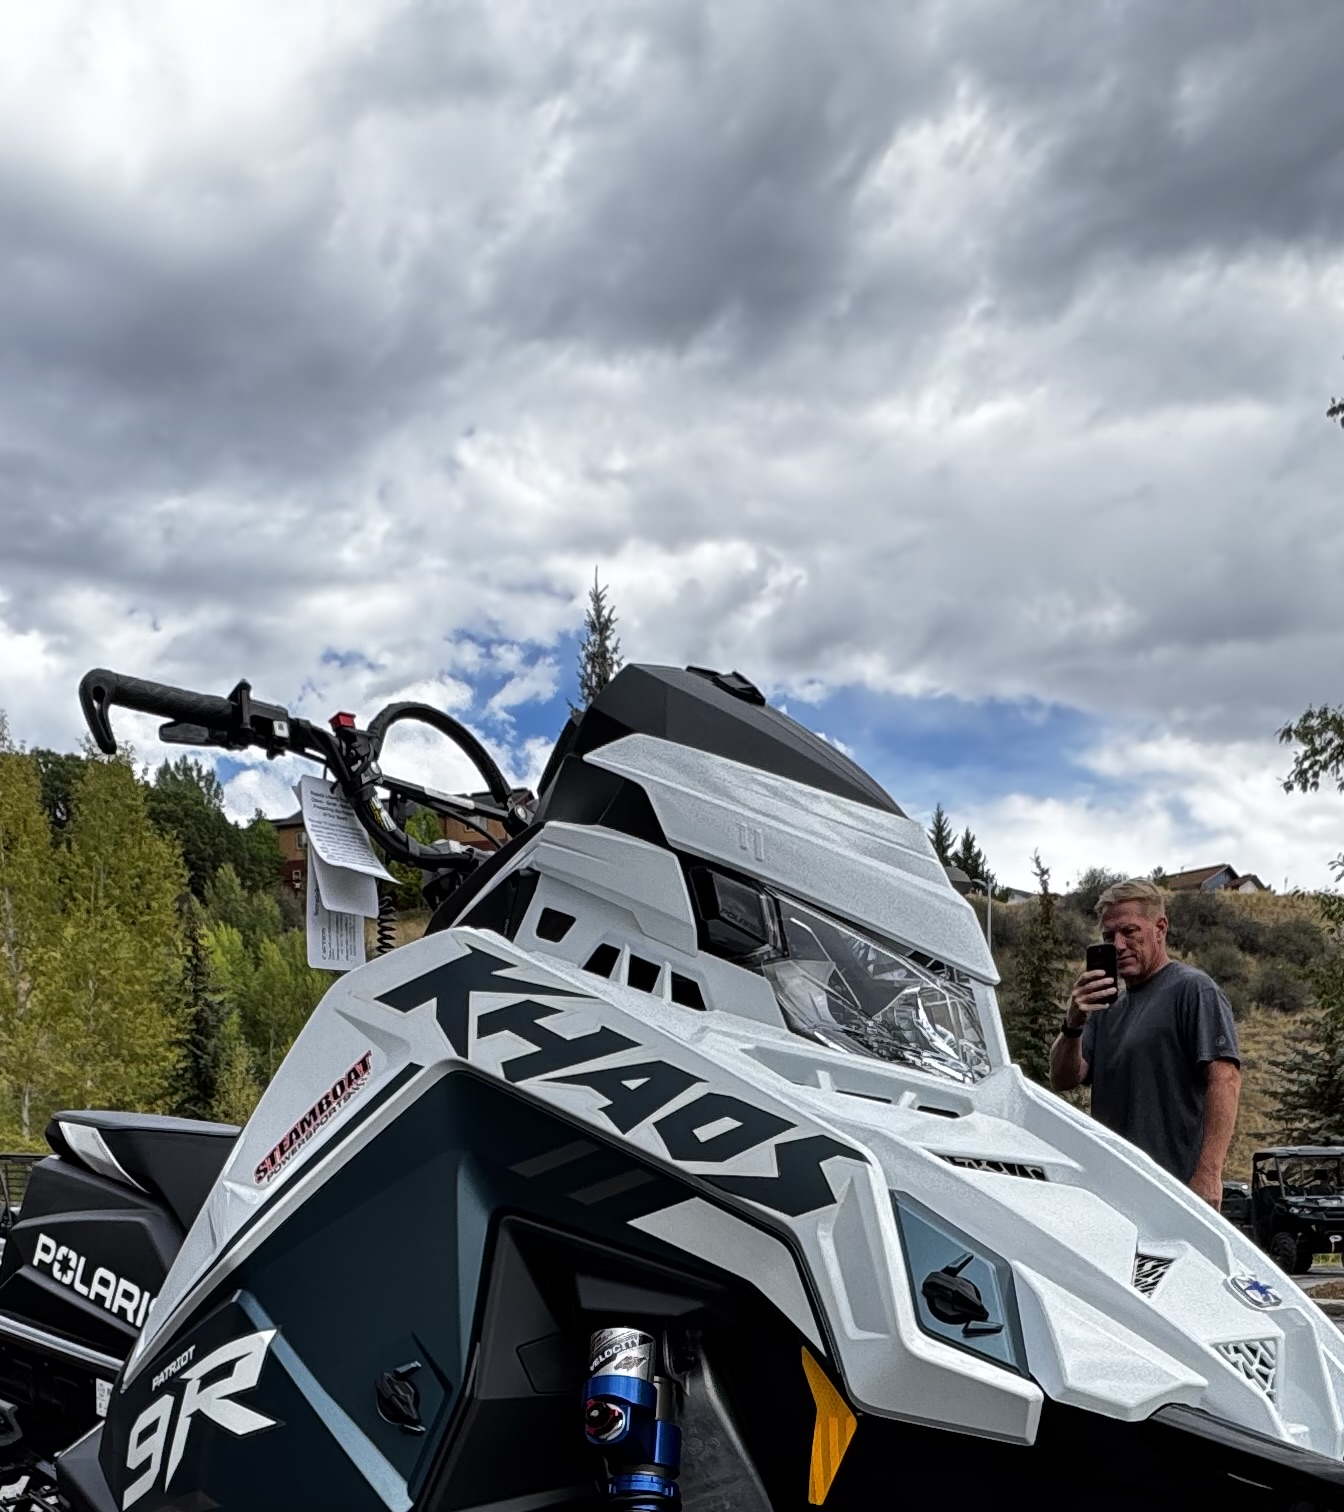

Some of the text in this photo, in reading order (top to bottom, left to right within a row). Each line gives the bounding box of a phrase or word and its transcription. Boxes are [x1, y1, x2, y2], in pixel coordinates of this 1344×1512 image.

[254, 1051, 372, 1183] STEAMBOAT
[374, 945, 869, 1217] KHAOS
[32, 1233, 157, 1328] POLARI
[151, 1344, 196, 1392] PATRIOT
[589, 1334, 639, 1371] VELOCITY
[122, 1329, 277, 1511] 9R
